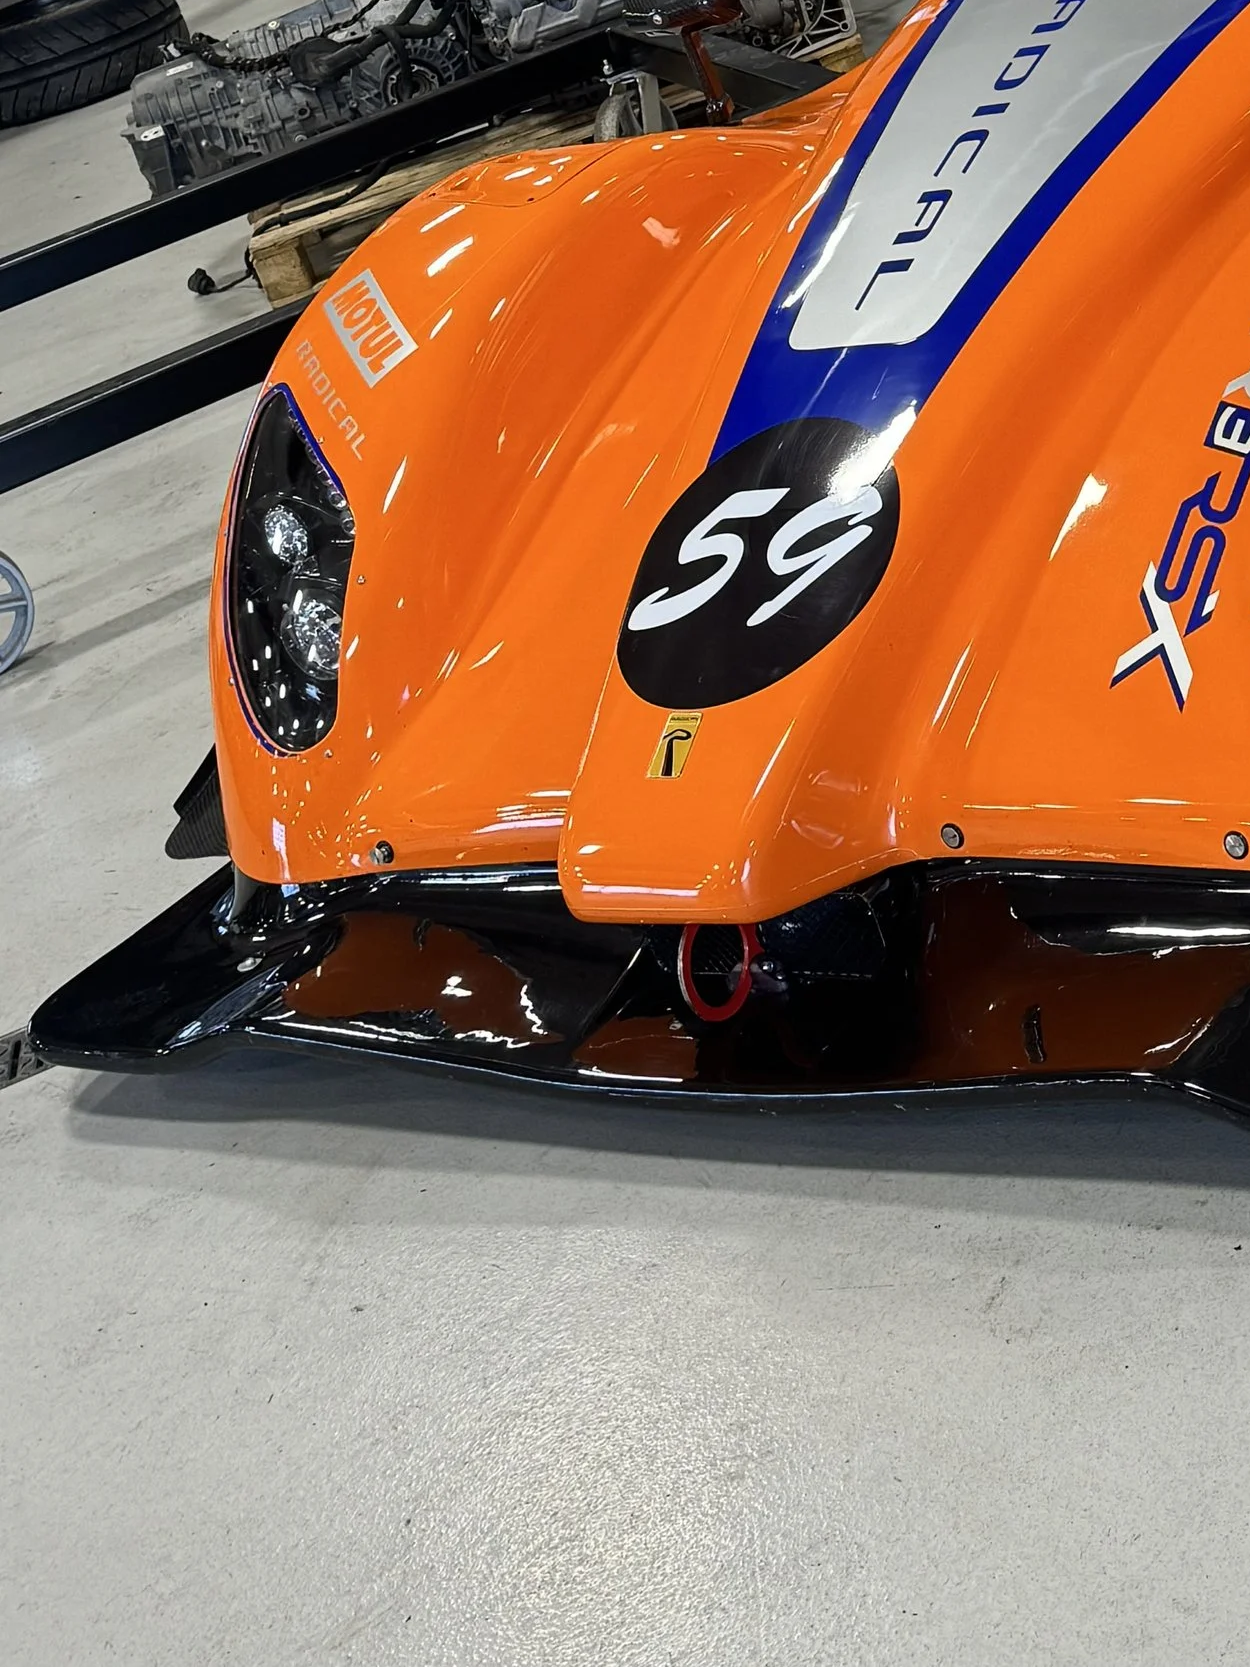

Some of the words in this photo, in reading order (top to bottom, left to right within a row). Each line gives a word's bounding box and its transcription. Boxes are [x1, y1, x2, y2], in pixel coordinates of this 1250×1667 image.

[330, 279, 405, 375] MOTUL
[295, 338, 366, 462] RADICAL
[627, 484, 884, 632] 59
